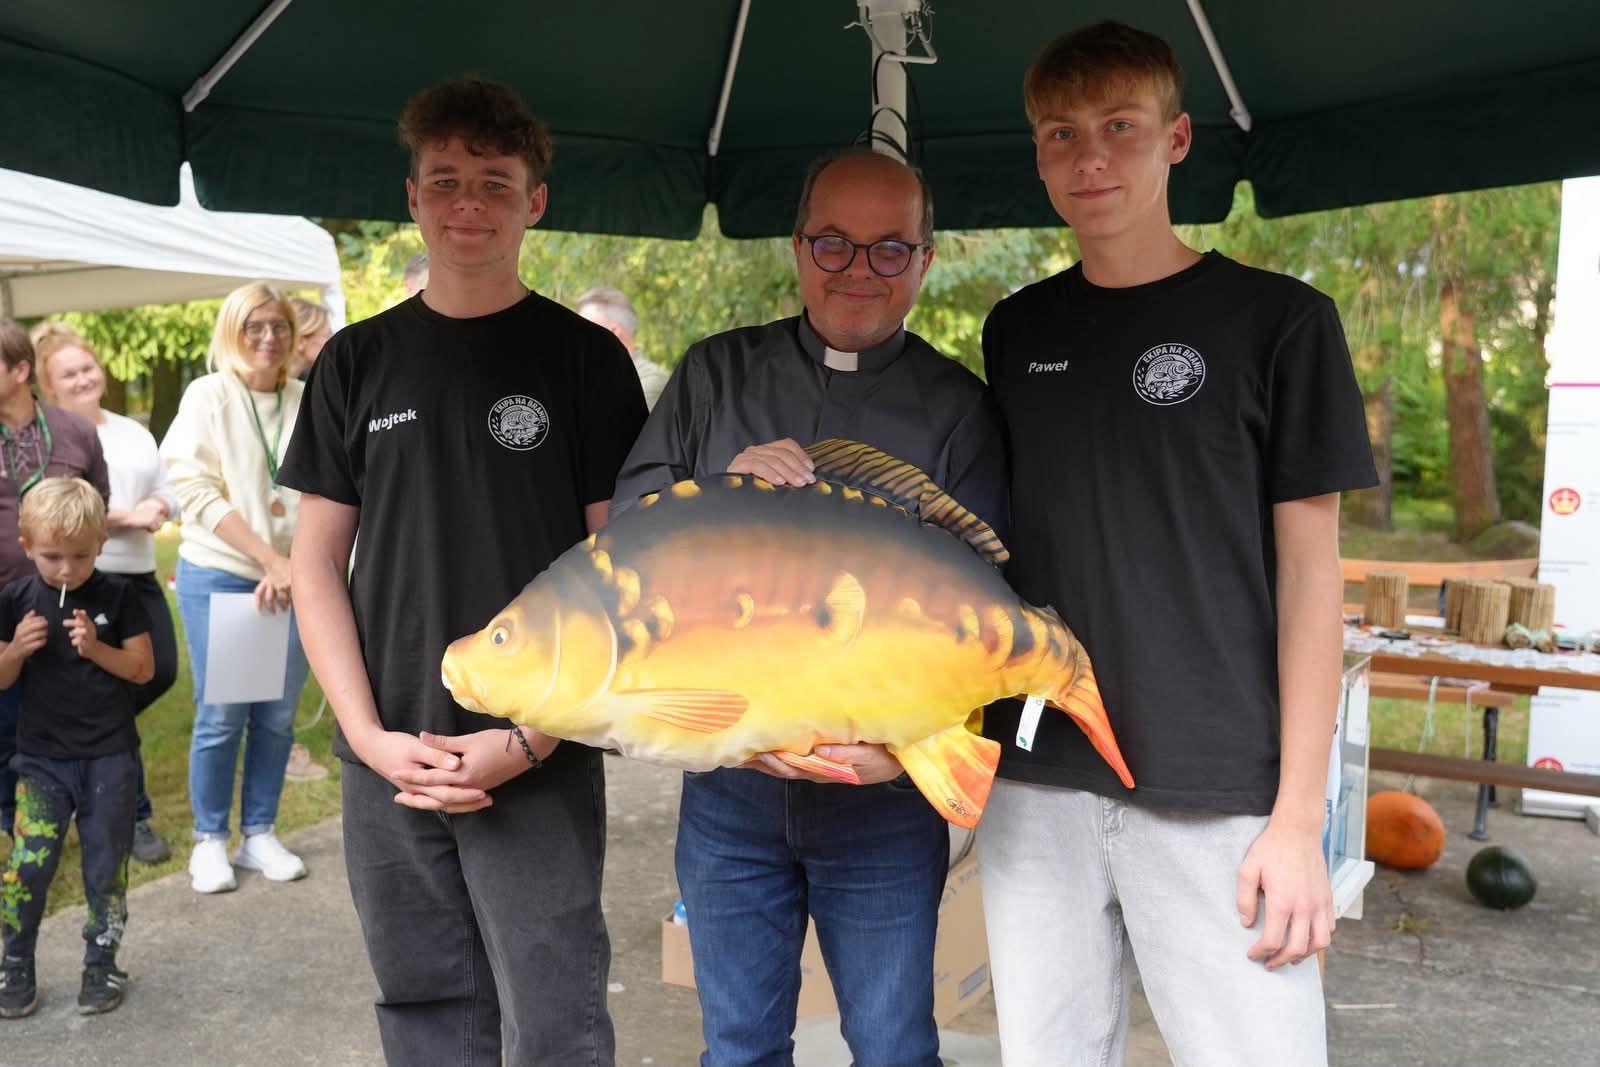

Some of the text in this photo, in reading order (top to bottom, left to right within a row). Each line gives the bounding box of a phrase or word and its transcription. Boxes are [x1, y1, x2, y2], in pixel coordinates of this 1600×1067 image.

[1142, 345, 1203, 375] EKIPA NA BRANIU
[494, 398, 515, 414] EKIPA
[515, 397, 527, 406] NA
[368, 408, 417, 433] Wojtek
